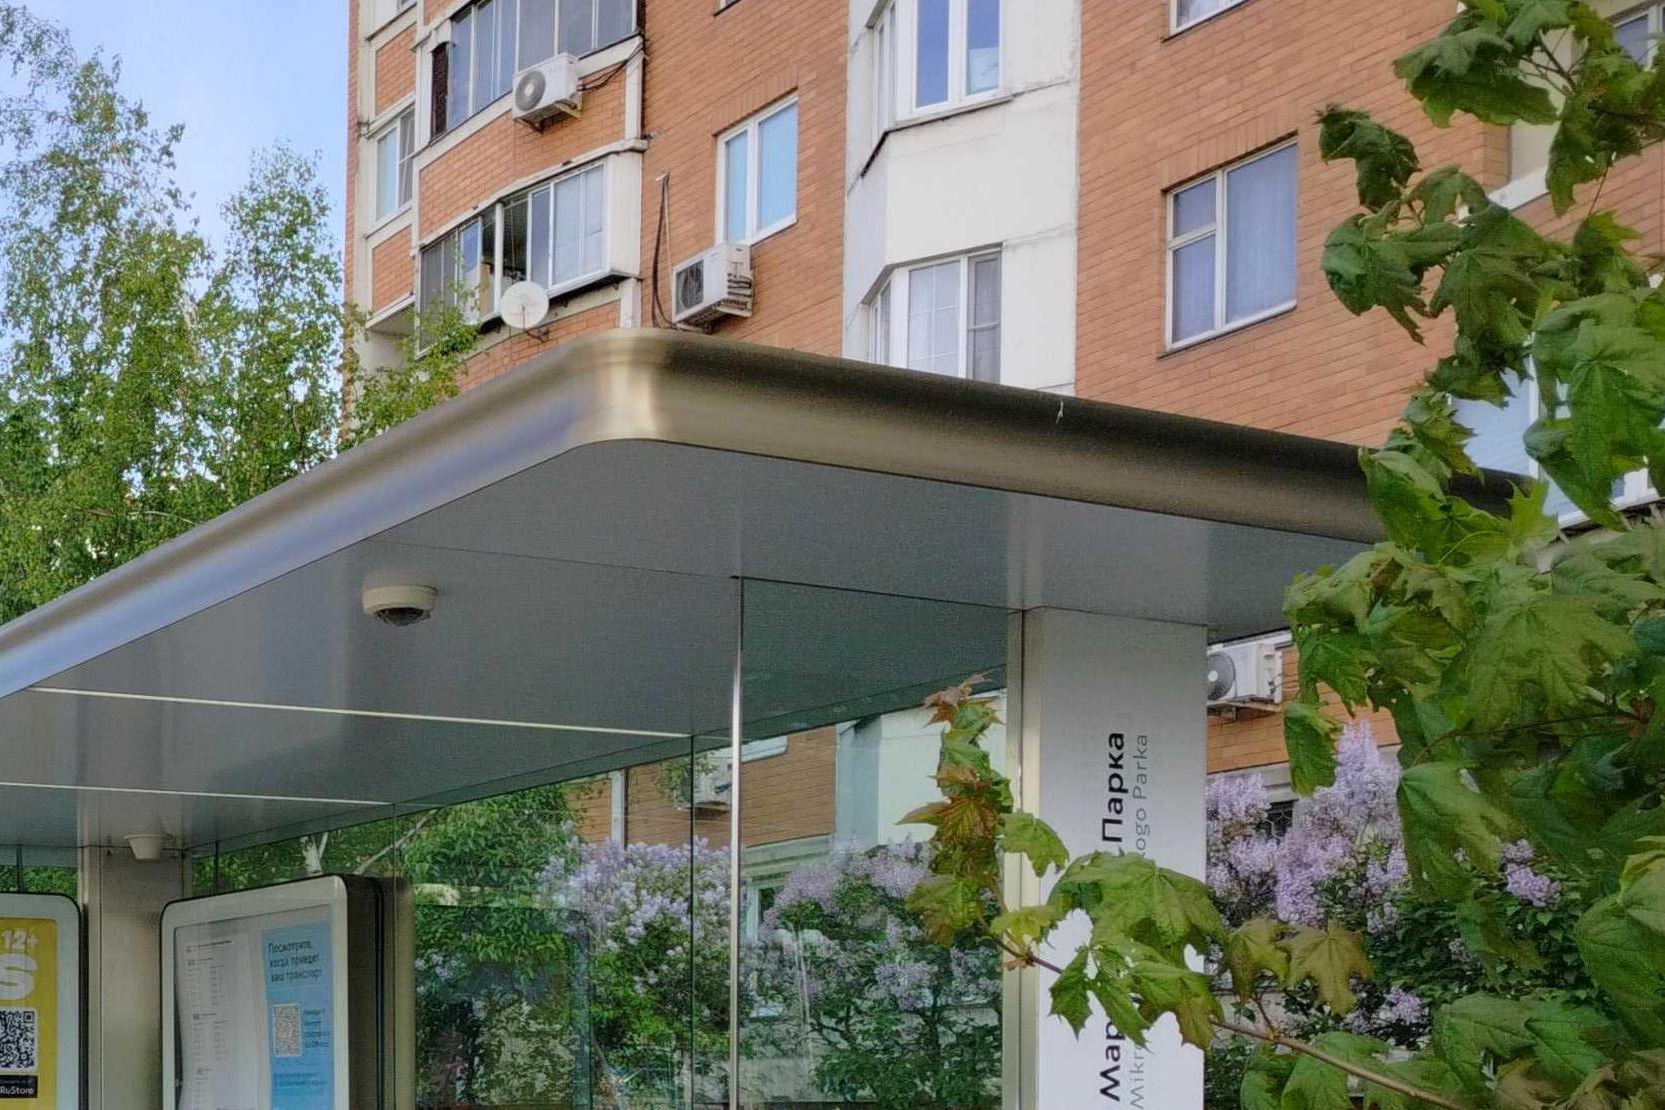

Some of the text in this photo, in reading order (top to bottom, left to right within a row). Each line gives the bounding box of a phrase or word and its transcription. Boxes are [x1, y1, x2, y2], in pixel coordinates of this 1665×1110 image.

[1101, 732, 1129, 842] Парка
[1133, 734, 1149, 800] Parka
[1, 929, 38, 951] 12+
[0, 1085, 35, 1096] RuStore
